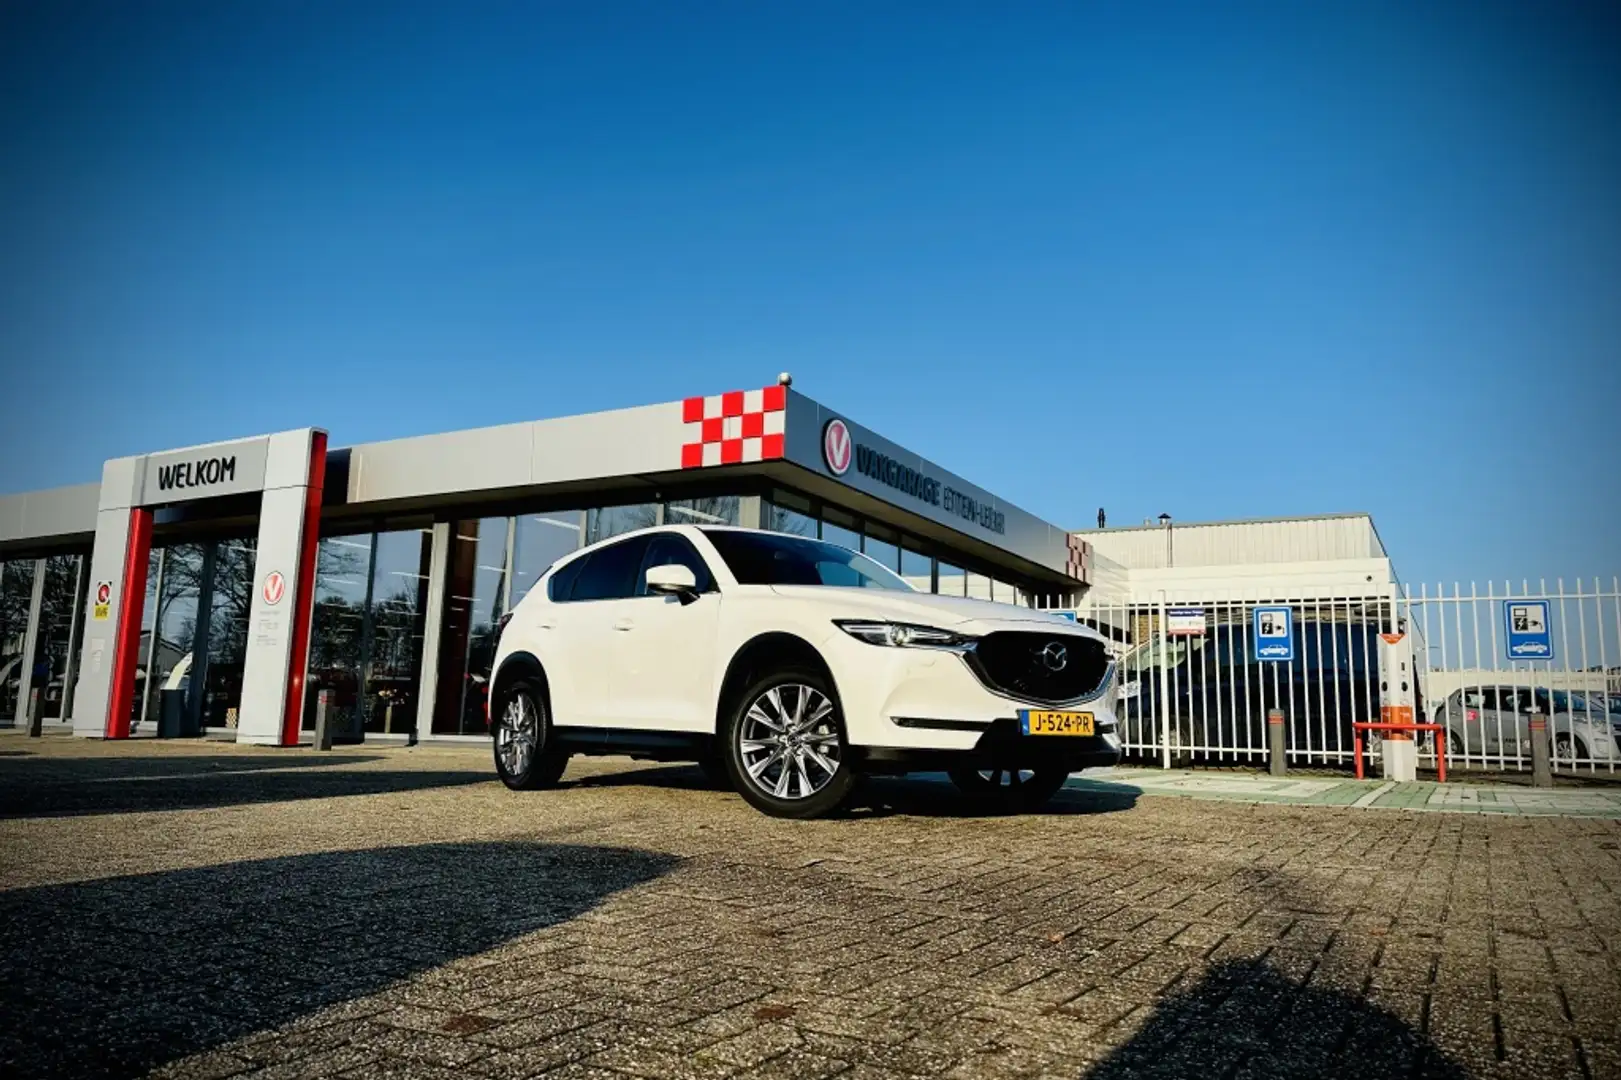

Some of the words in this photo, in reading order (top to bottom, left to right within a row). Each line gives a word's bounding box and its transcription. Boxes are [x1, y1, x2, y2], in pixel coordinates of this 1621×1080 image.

[158, 456, 236, 491] WELKOM
[855, 443, 942, 506] VAKGARAGE
[1035, 713, 1090, 733] J-524-PR
